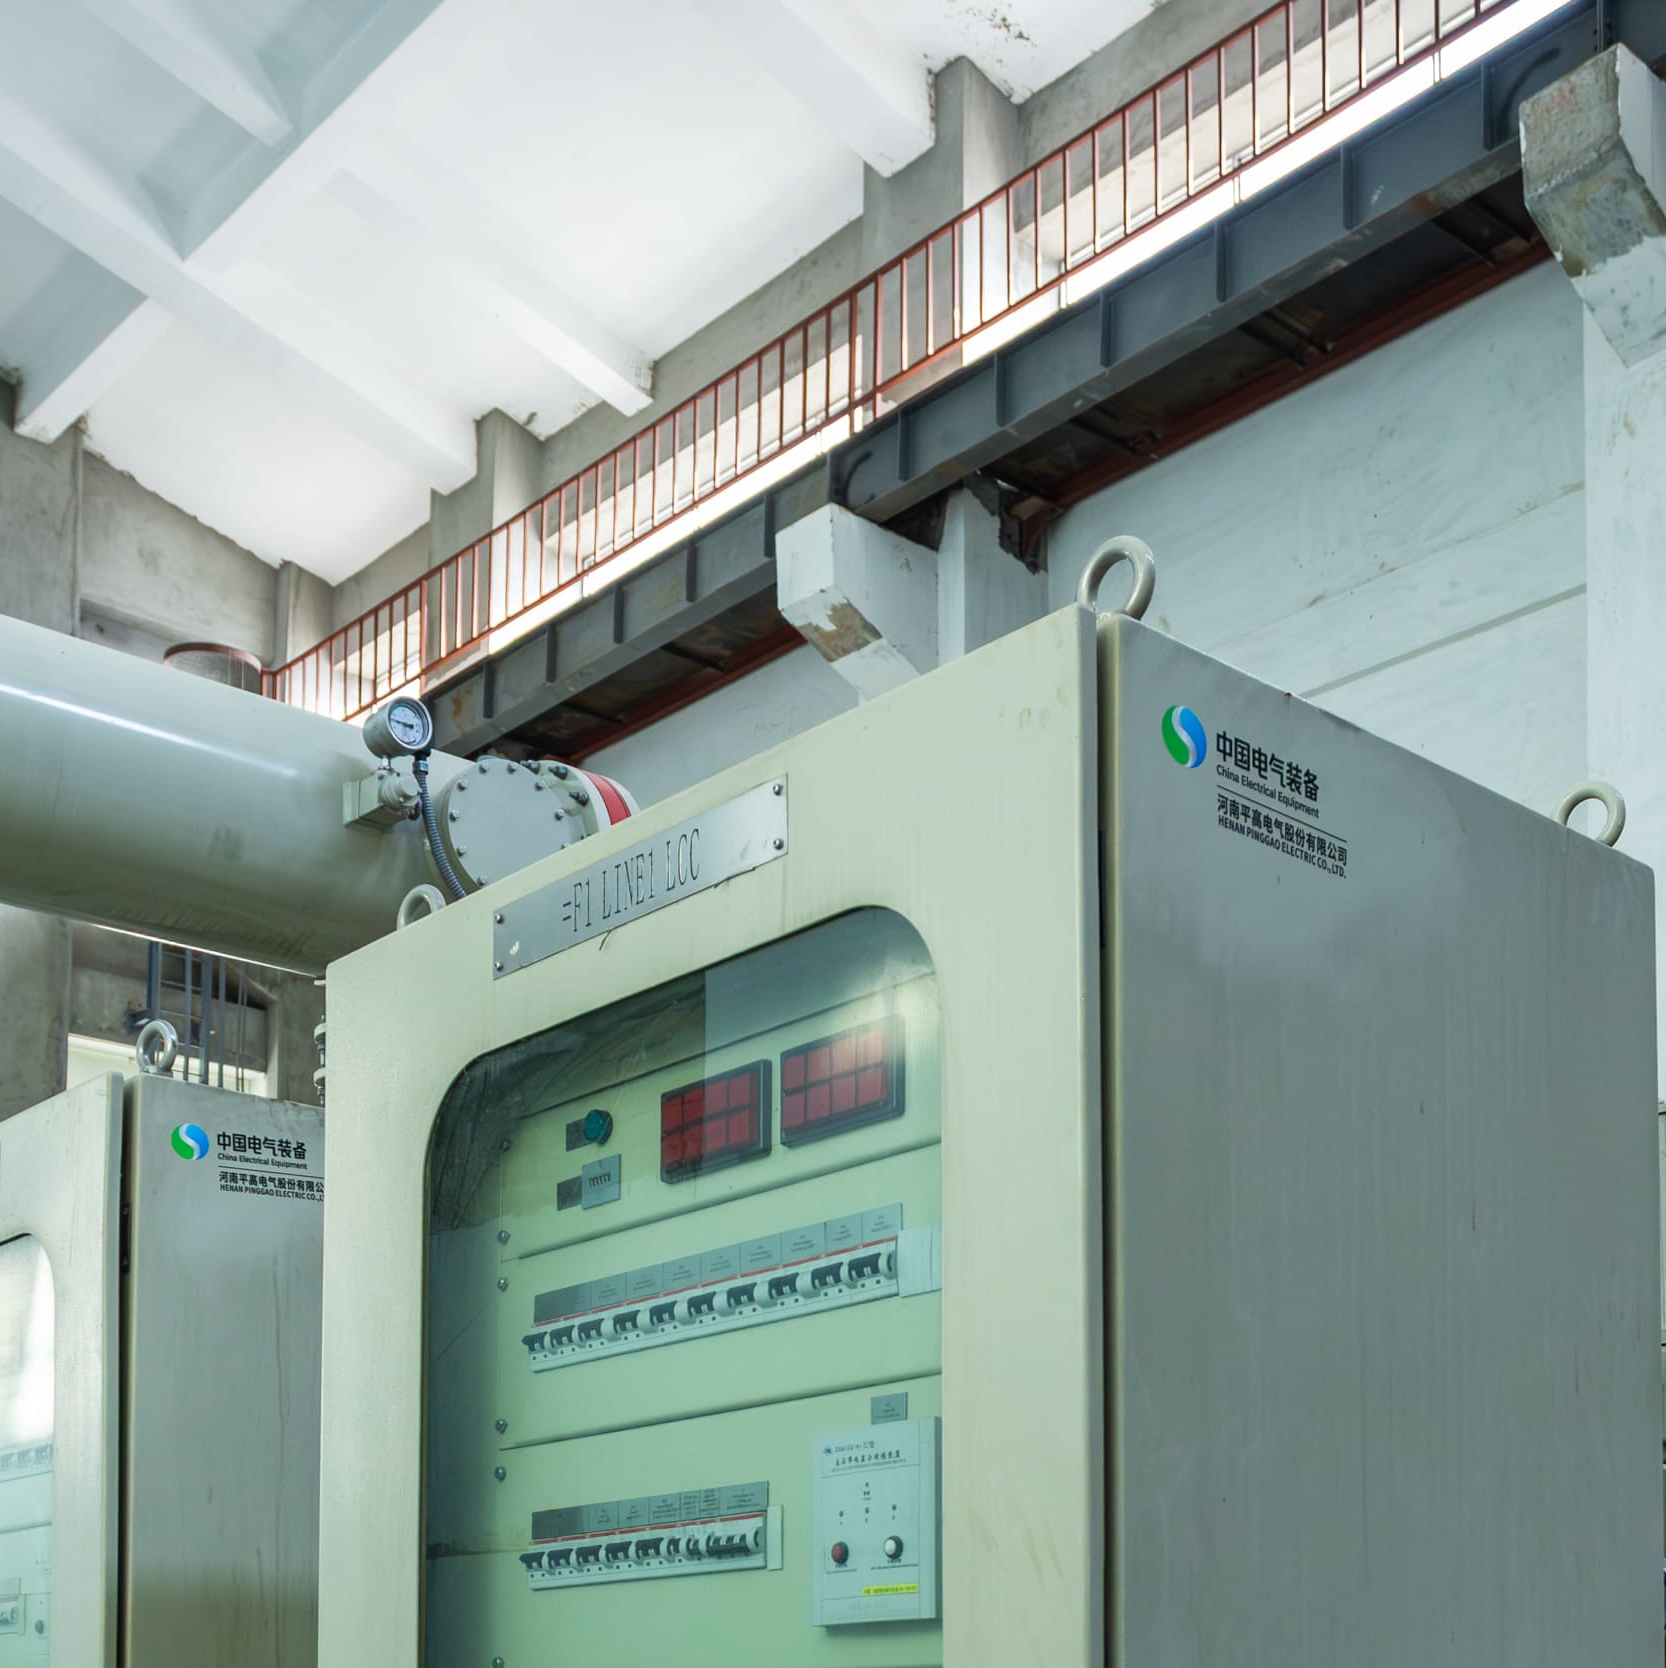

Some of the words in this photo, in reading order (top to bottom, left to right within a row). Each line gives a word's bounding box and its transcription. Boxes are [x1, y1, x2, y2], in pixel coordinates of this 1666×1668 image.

[1216, 731, 1320, 802] 中国电气装备
[1216, 764, 1240, 783] China
[1241, 774, 1277, 800] Electrical
[1277, 791, 1320, 819] Equipment
[1217, 793, 1348, 867] 河南平高电气股份有限公司
[1218, 815, 1246, 836] HENAN
[1246, 827, 1281, 851] PINGGAO
[1281, 842, 1317, 866] ELECTRIC
[602, 847, 655, 920] LINE1
[666, 828, 700, 891] LCC
[217, 1131, 308, 1160] 中国电气装备
[217, 1152, 238, 1163] China
[238, 1156, 270, 1166] Electrical
[270, 1159, 308, 1170] Equipment
[220, 1184, 244, 1194] HENAN
[244, 1187, 274, 1197] PINGGAO
[275, 1190, 306, 1200] ELECTRIC
